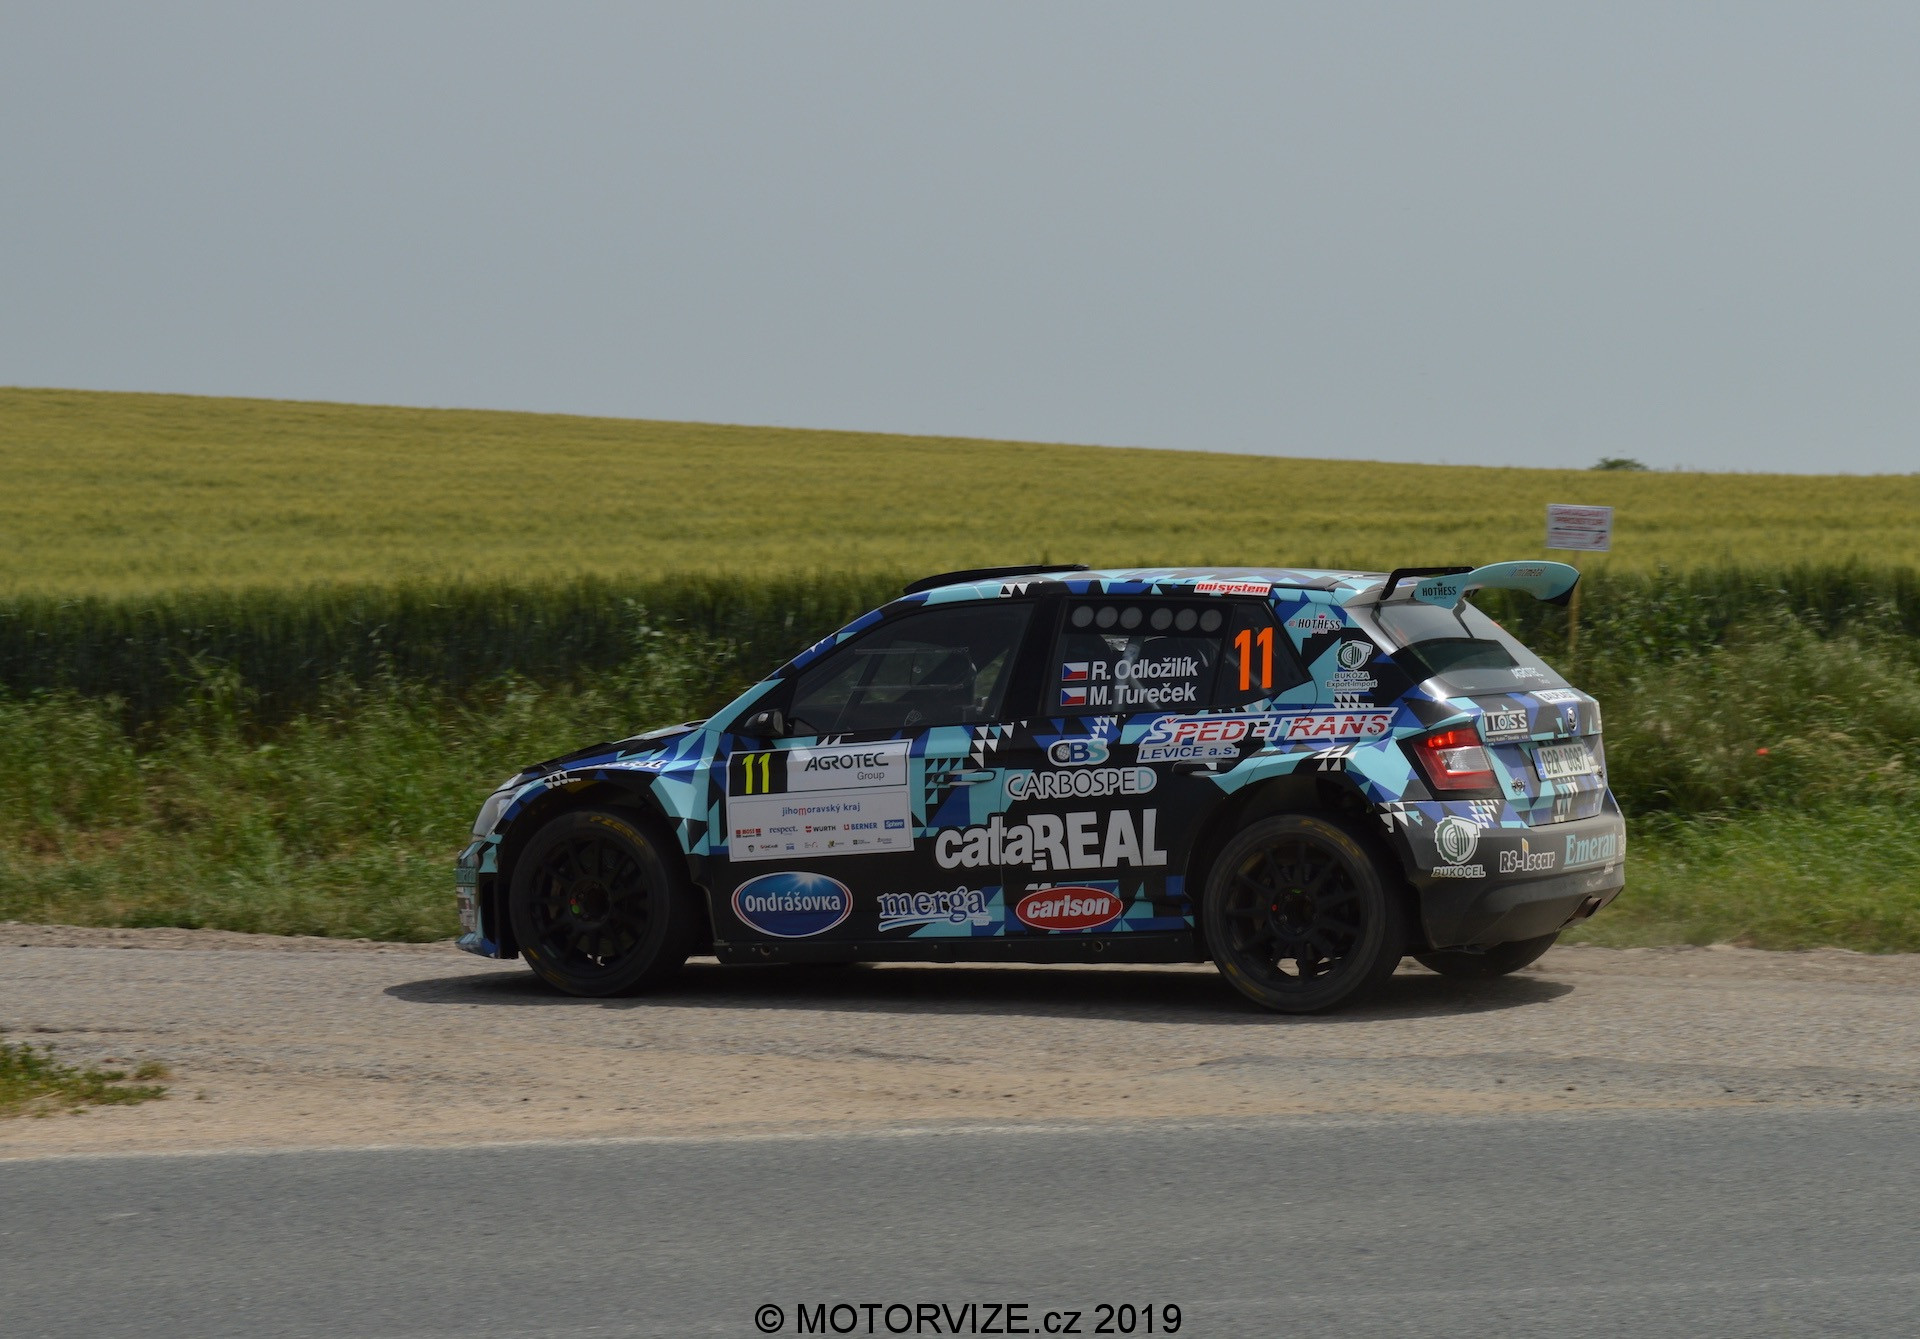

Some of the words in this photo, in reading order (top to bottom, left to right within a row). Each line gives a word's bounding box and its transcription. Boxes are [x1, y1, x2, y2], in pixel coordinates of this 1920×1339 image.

[1422, 586, 1457, 596] HOTHESS
[1298, 618, 1341, 630] HOTHESS
[1091, 660, 1112, 680] R.
[1114, 656, 1199, 679] Odložilík
[1234, 627, 1274, 691] 11
[1089, 685, 1112, 706] M.
[1114, 682, 1197, 705] Tureček
[805, 752, 889, 771] AGROTEC
[1050, 740, 1107, 763] CBS
[1140, 746, 1203, 760] LEVICE
[1208, 747, 1237, 756] a.s.
[742, 753, 771, 794] 11
[857, 771, 885, 781] Group
[1008, 770, 1154, 797] CARBOSPED
[782, 804, 840, 816] jihomoravský
[843, 802, 860, 812] kraj
[769, 826, 798, 835] respect.
[851, 822, 877, 831] BERNER
[935, 808, 1168, 871] cataREAL
[1564, 834, 1616, 865] Emeran
[1433, 866, 1484, 878] BUKOCEL
[744, 892, 841, 912] Ondrášovka
[880, 887, 987, 922] merga
[1027, 895, 1110, 919] carlson
